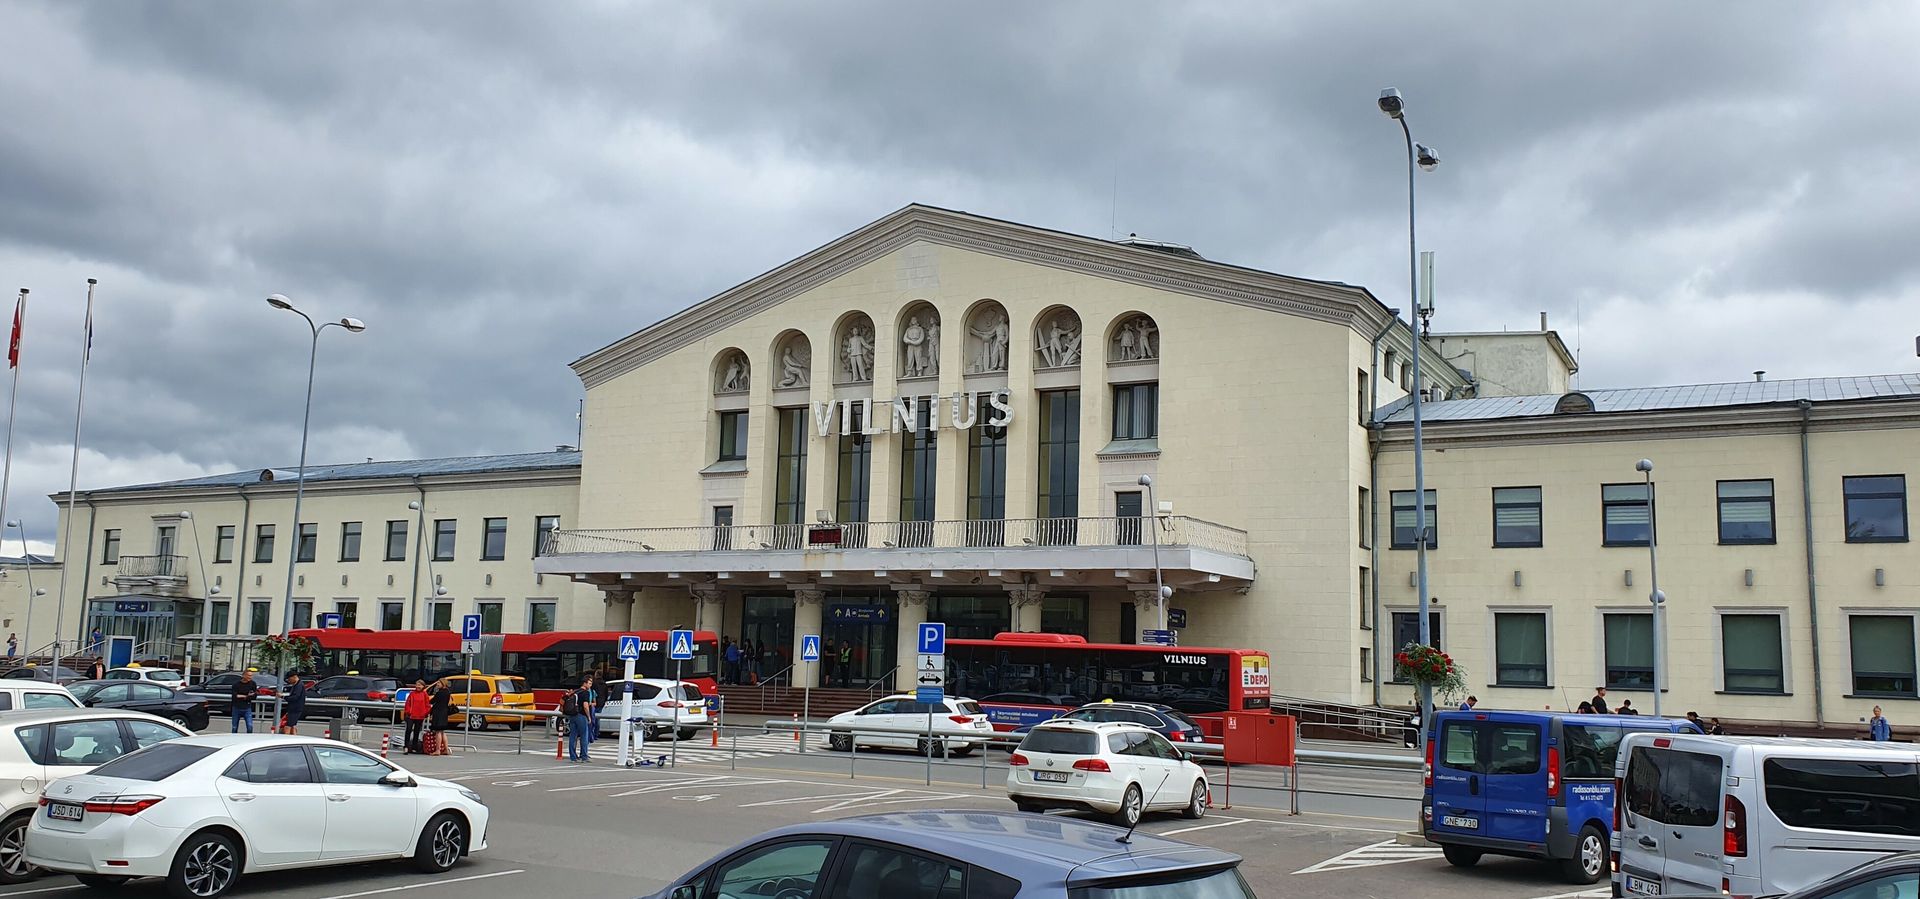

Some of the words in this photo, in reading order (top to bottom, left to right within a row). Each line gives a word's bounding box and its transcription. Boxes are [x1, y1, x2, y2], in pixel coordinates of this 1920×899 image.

[813, 387, 1015, 437] VILNIUS
[467, 617, 478, 638] P
[924, 627, 939, 650] P
[1163, 654, 1207, 665] VILNIUS
[1250, 674, 1268, 685] DEPO
[52, 804, 66, 816] JSD
[69, 806, 81, 818] 614
[1444, 816, 1460, 826] GNE
[1463, 818, 1477, 827] 730
[1646, 883, 1659, 896] 423
